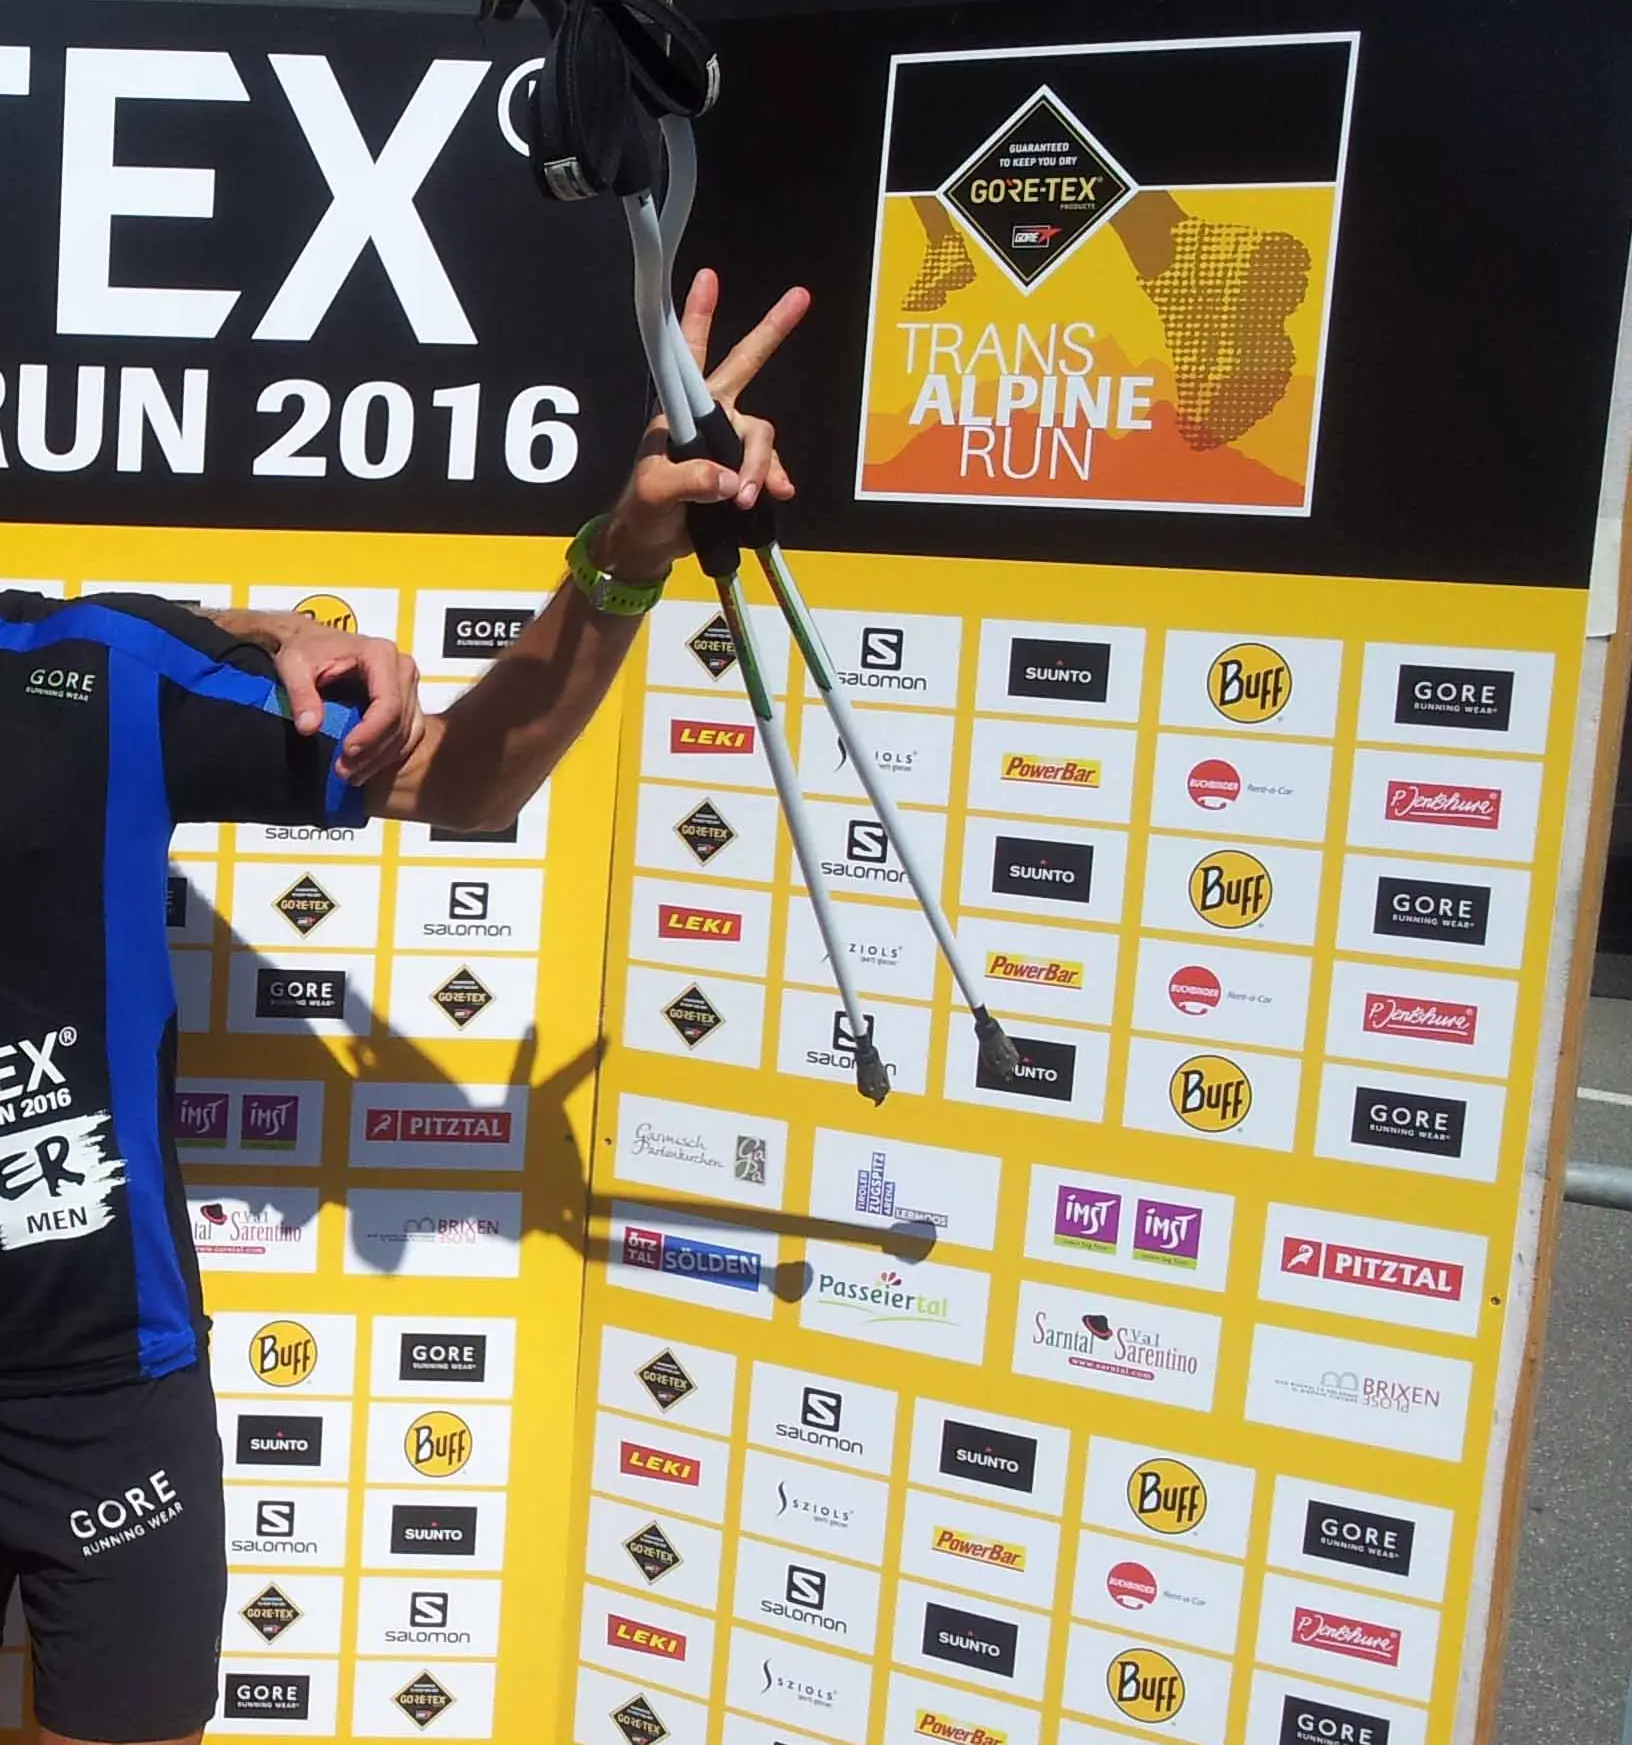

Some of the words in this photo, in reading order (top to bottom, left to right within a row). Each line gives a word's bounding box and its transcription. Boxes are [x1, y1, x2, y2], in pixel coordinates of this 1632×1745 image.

[1009, 142, 1069, 153] GUARANTEED
[1000, 158, 1010, 167] TO
[1012, 158, 1036, 167] KEEP
[1038, 157, 1056, 166] YOU
[970, 176, 1096, 204] GORE-TEX
[897, 322, 1096, 375] TRANS
[908, 373, 1154, 430] ALPINE
[252, 379, 580, 483] 2016
[959, 425, 1094, 482] RUN
[456, 620, 522, 638] GORE
[29, 668, 96, 692] GORE
[1025, 667, 1092, 683] SUUNTO
[1414, 682, 1497, 704] GORE
[1414, 702, 1460, 713] RUNNING
[679, 727, 745, 747] LEKI
[1006, 757, 1096, 783] PowerBar
[681, 824, 728, 840] GORE-TEX
[1009, 864, 1076, 884] SUUNTO
[280, 899, 330, 911] GORE-TEX
[1392, 894, 1474, 918] GORE
[667, 914, 733, 934] LEKI
[1391, 913, 1439, 926] RUNNING
[989, 956, 1078, 985] PowerBar
[270, 982, 334, 998] GORE
[438, 991, 487, 1004] GORE-TEX
[669, 1009, 716, 1025] GORE-TEX
[21, 1088, 73, 1119] 2016
[410, 1117, 503, 1137] PITZTAL
[1369, 1103, 1450, 1133] GORE
[1369, 1123, 1417, 1138] RUNNING
[870, 1154, 885, 1213] ZUGSPITZ
[26, 1206, 89, 1235] MEN
[230, 1211, 303, 1243] Sarentino
[438, 1218, 499, 1234] BRIXEN
[627, 1232, 660, 1251] ÖTZ
[627, 1247, 658, 1264] TAL
[665, 1246, 759, 1276] SÖLDEN
[1335, 1255, 1453, 1292] PITZTAL
[819, 1273, 948, 1318] Passeiertal
[412, 1346, 474, 1362] GORE
[1033, 1312, 1096, 1355] Sarntal
[1115, 1327, 1198, 1374] Sarentino
[643, 1370, 688, 1390] GORE-TEX
[1364, 1378, 1440, 1407] BRIXEN
[250, 1438, 309, 1451] SUUNTO
[629, 1451, 691, 1479] LEKI
[956, 1448, 1019, 1473] SUUNTO
[69, 1469, 178, 1541] GORE
[81, 1521, 145, 1559] RUNNING
[147, 1501, 185, 1530] WEAR
[404, 1528, 463, 1542] SUUNTO
[1321, 1518, 1398, 1550] GORE
[629, 1542, 675, 1563] GORE-TEX
[937, 1530, 1022, 1567] PowerBar
[247, 1606, 294, 1619] GORE-TEX
[615, 1623, 677, 1653] LEKI
[938, 1630, 1001, 1658] SUUNTO
[236, 1685, 298, 1701] GORE
[399, 1693, 447, 1706] GORE-TEX
[617, 1714, 661, 1736] GORE-TEX
[919, 1712, 1003, 1745] PowerBar
[1297, 1714, 1375, 1745] GORE
